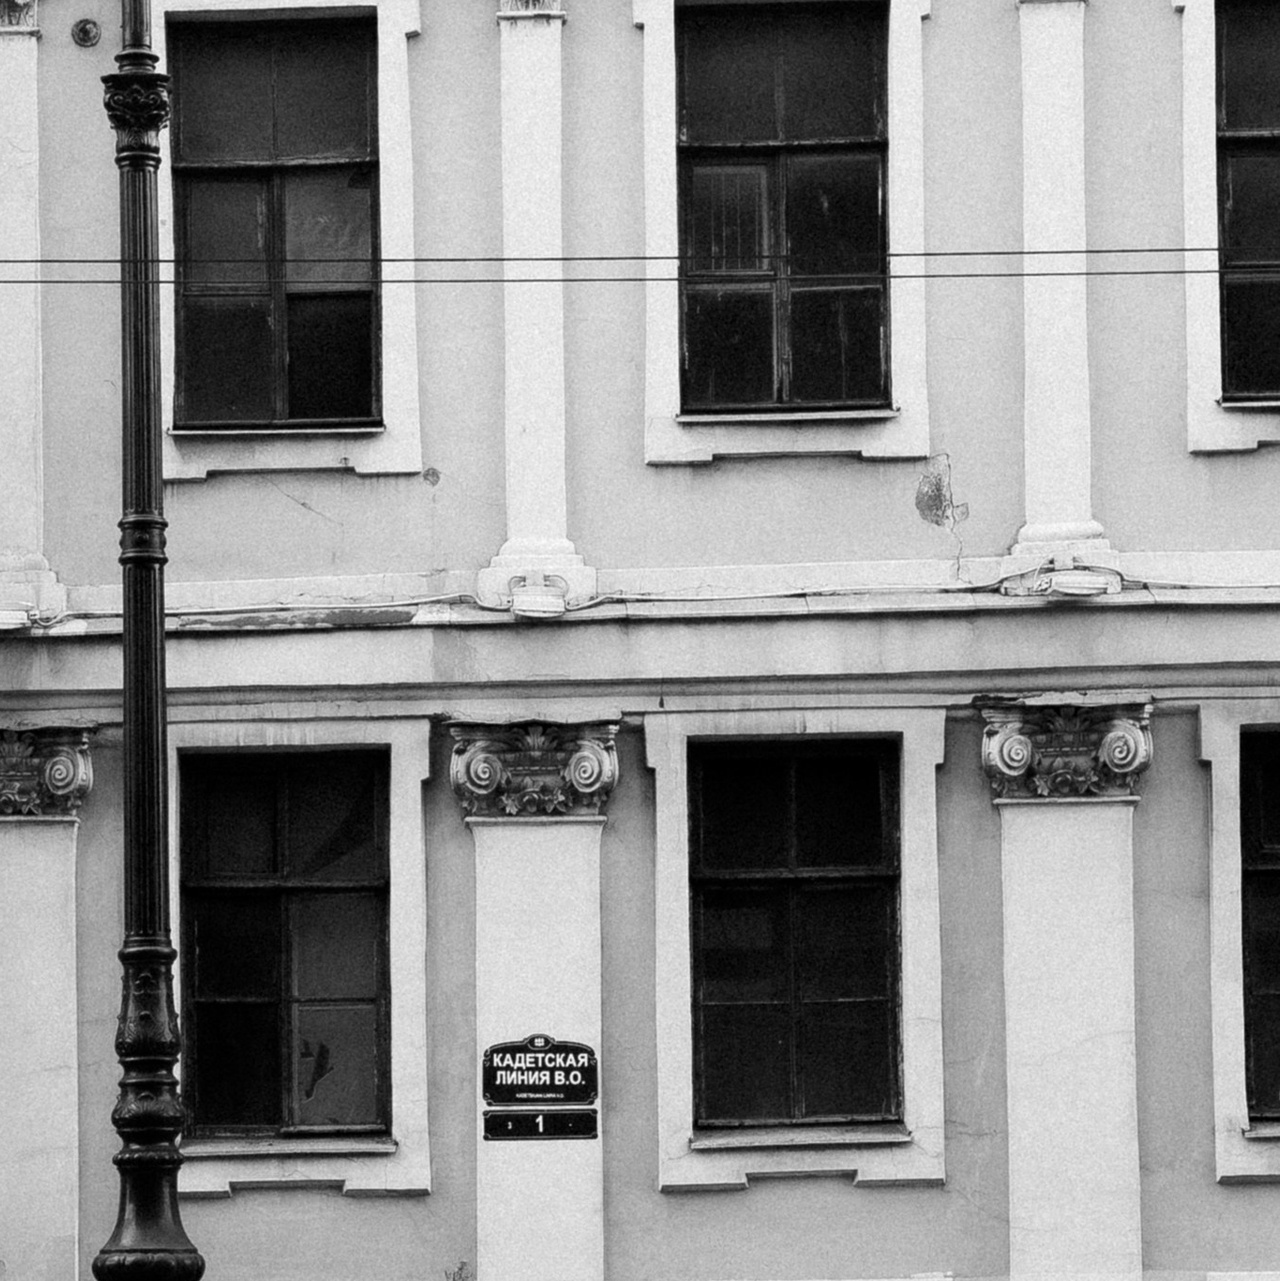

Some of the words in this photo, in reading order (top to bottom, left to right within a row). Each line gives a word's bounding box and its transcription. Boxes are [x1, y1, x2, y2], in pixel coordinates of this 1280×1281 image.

[493, 1053, 589, 1070] КАДЕТСКАЯ
[495, 1071, 551, 1085] ЛИНИЯ
[554, 1071, 586, 1085] В.О.
[535, 1114, 544, 1133] 1
